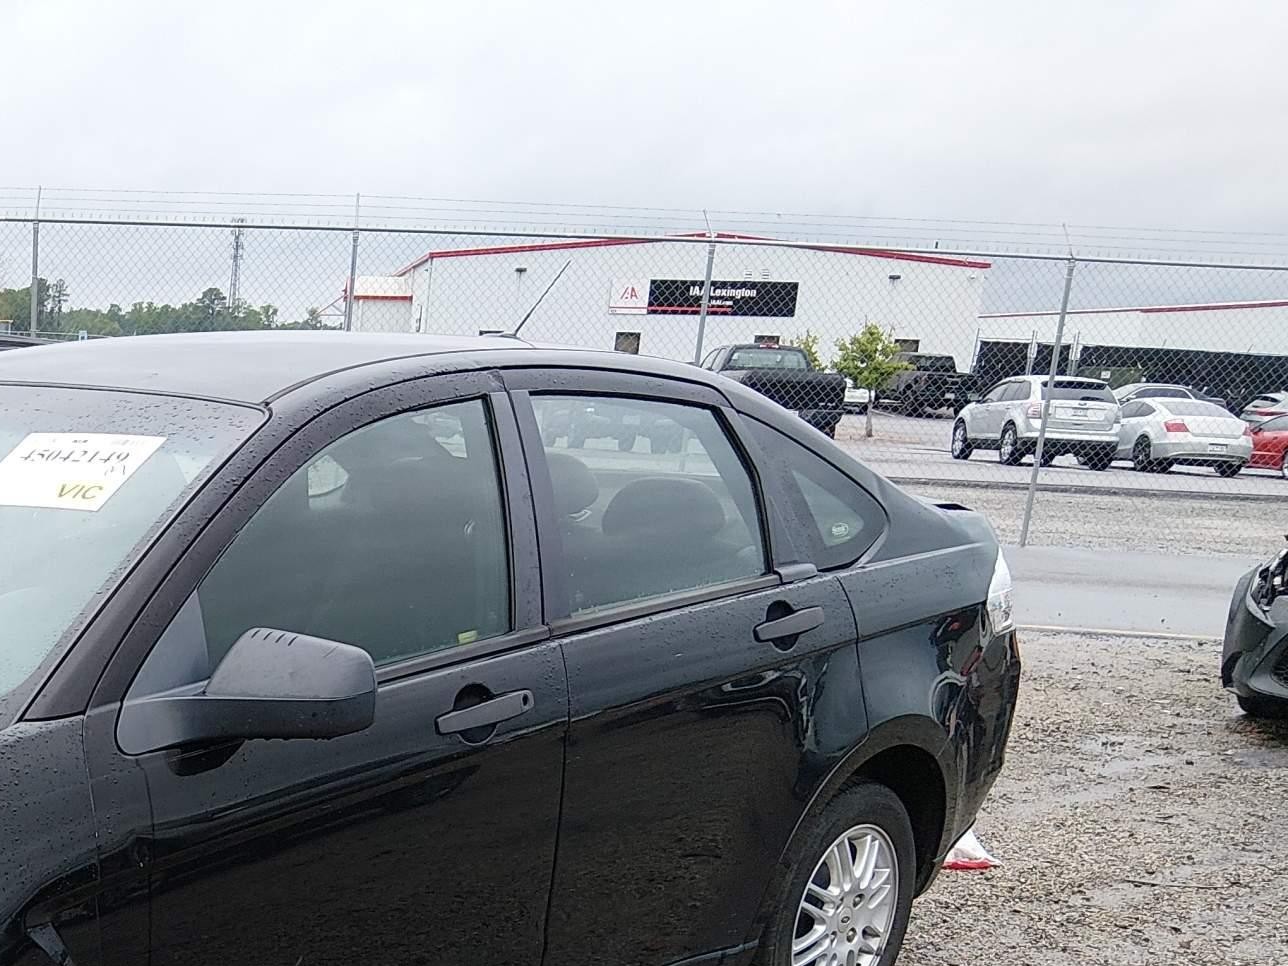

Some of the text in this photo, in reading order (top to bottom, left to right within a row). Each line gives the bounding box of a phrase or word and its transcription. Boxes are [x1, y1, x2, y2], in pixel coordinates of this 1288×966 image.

[710, 286, 757, 299] Lexington
[20, 448, 130, 463] 45042149
[57, 483, 104, 500] VIC
